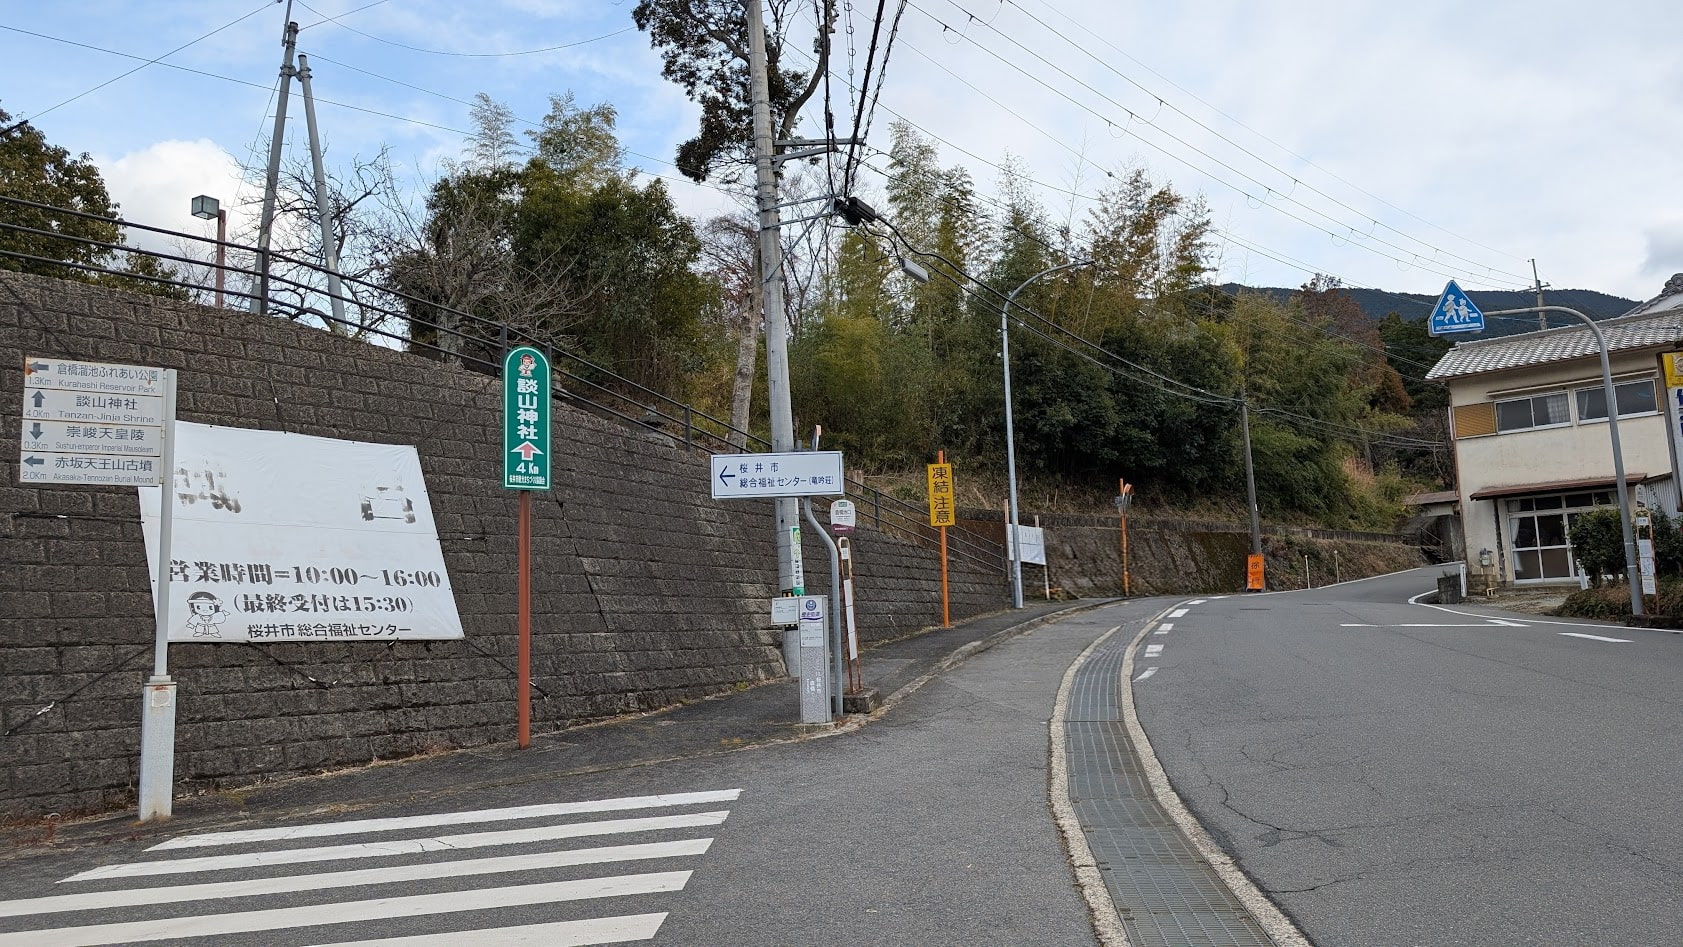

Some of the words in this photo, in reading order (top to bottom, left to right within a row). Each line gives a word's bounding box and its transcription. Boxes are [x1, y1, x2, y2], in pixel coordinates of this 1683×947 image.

[29, 377, 52, 386] 1.3Km
[58, 379, 98, 389] Kurahashi
[99, 382, 135, 392] Reservoir
[138, 385, 156, 394] Park
[76, 395, 138, 410] 談山神社
[25, 409, 50, 419] 4.0Km
[516, 378, 539, 440] 談山神社
[59, 411, 121, 421] Tanzan-Jinja
[123, 414, 154, 423] Shrine
[66, 425, 145, 441] 崇峻天皇陵
[24, 441, 49, 450] 0.3Km
[55, 456, 153, 472] 赤坂天王山古墳
[515, 462, 527, 474] 4
[739, 462, 779, 474] 桜井市
[22, 471, 47, 480] 2.0Km
[114, 475, 133, 483] Burial
[133, 476, 153, 484] Mound
[932, 466, 951, 524] 凍結注意
